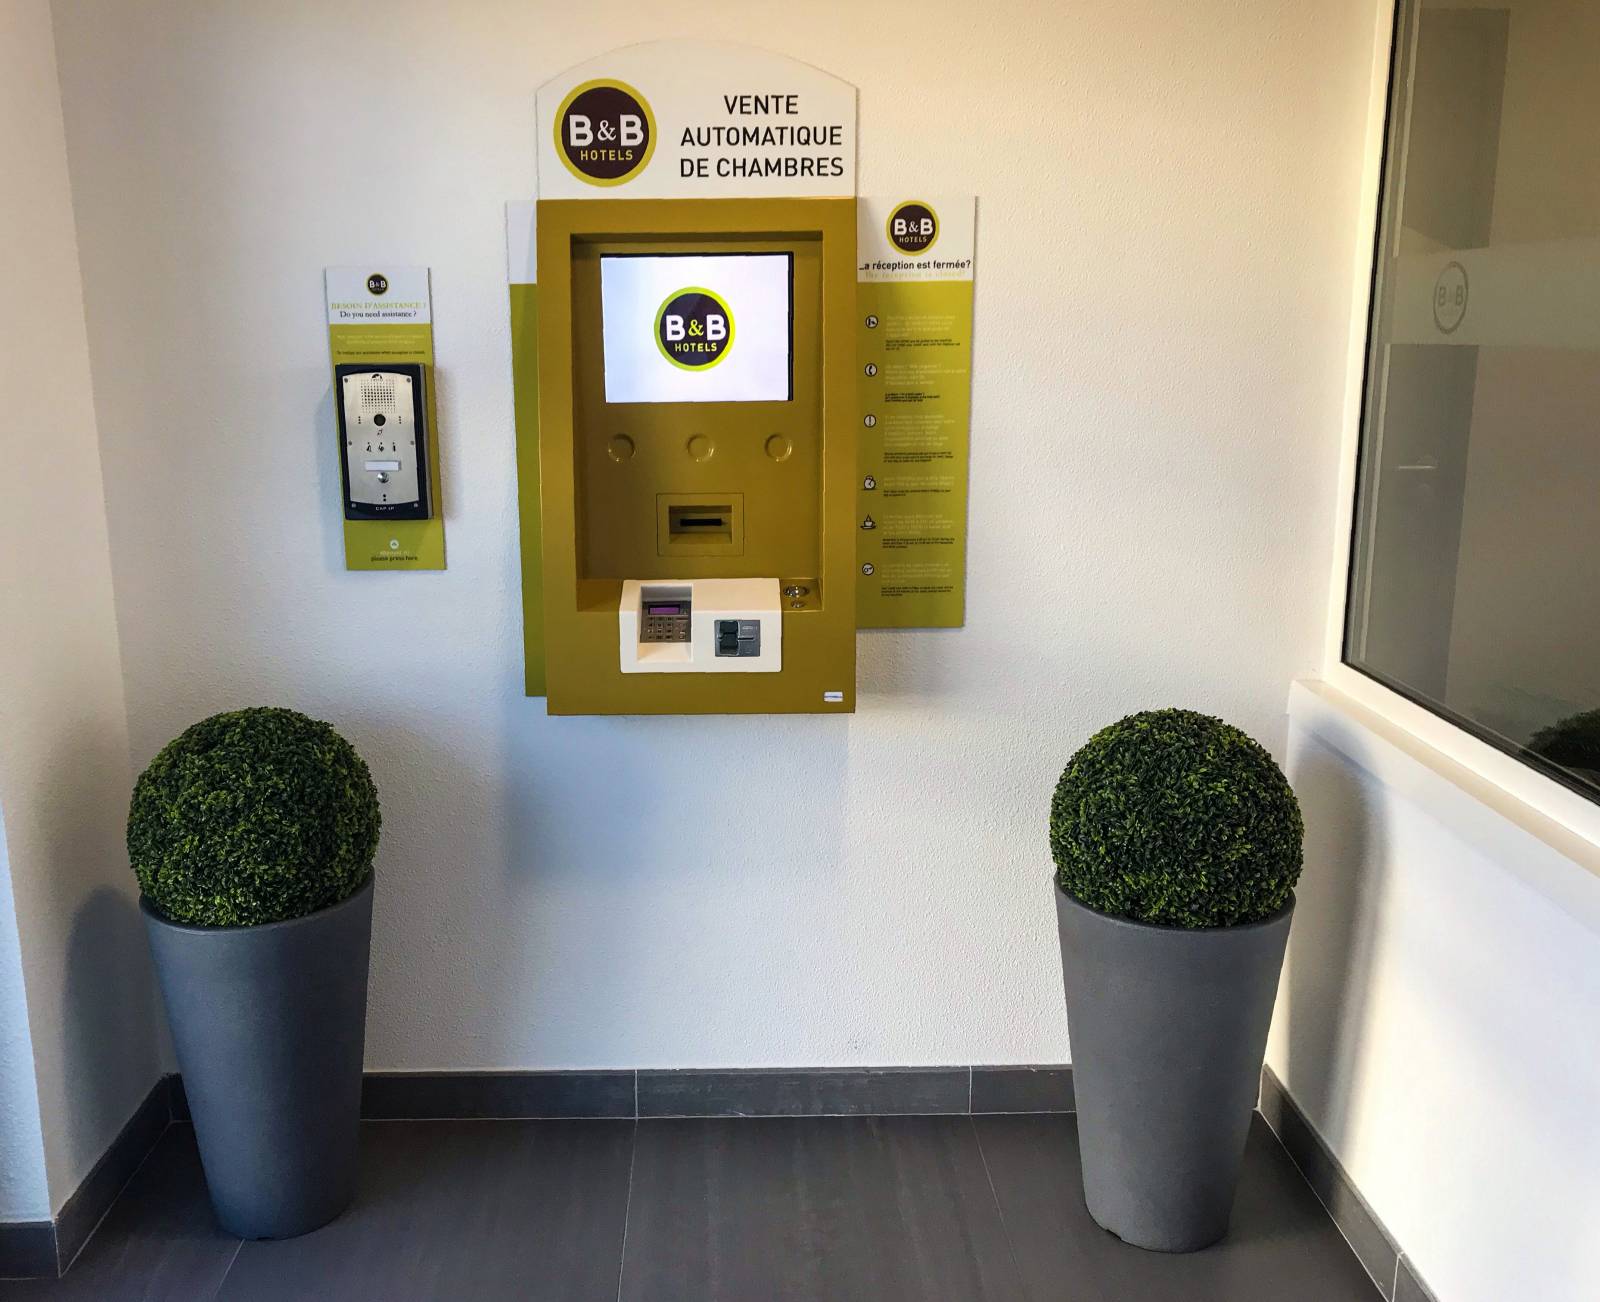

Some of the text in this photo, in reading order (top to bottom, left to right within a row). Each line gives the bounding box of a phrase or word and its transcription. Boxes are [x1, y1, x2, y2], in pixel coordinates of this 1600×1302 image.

[723, 95, 799, 115] VENTE
[569, 114, 644, 147] B&B
[680, 126, 843, 147] AUTOMATIQUE
[580, 150, 633, 161] HOTELS
[680, 157, 844, 177] DE CHAMBRES
[894, 218, 933, 235] B&B
[872, 260, 915, 272] réception
[917, 261, 930, 270] est
[933, 259, 971, 270] fermée?
[665, 314, 727, 341] B&B
[674, 342, 718, 352] HOTELS
